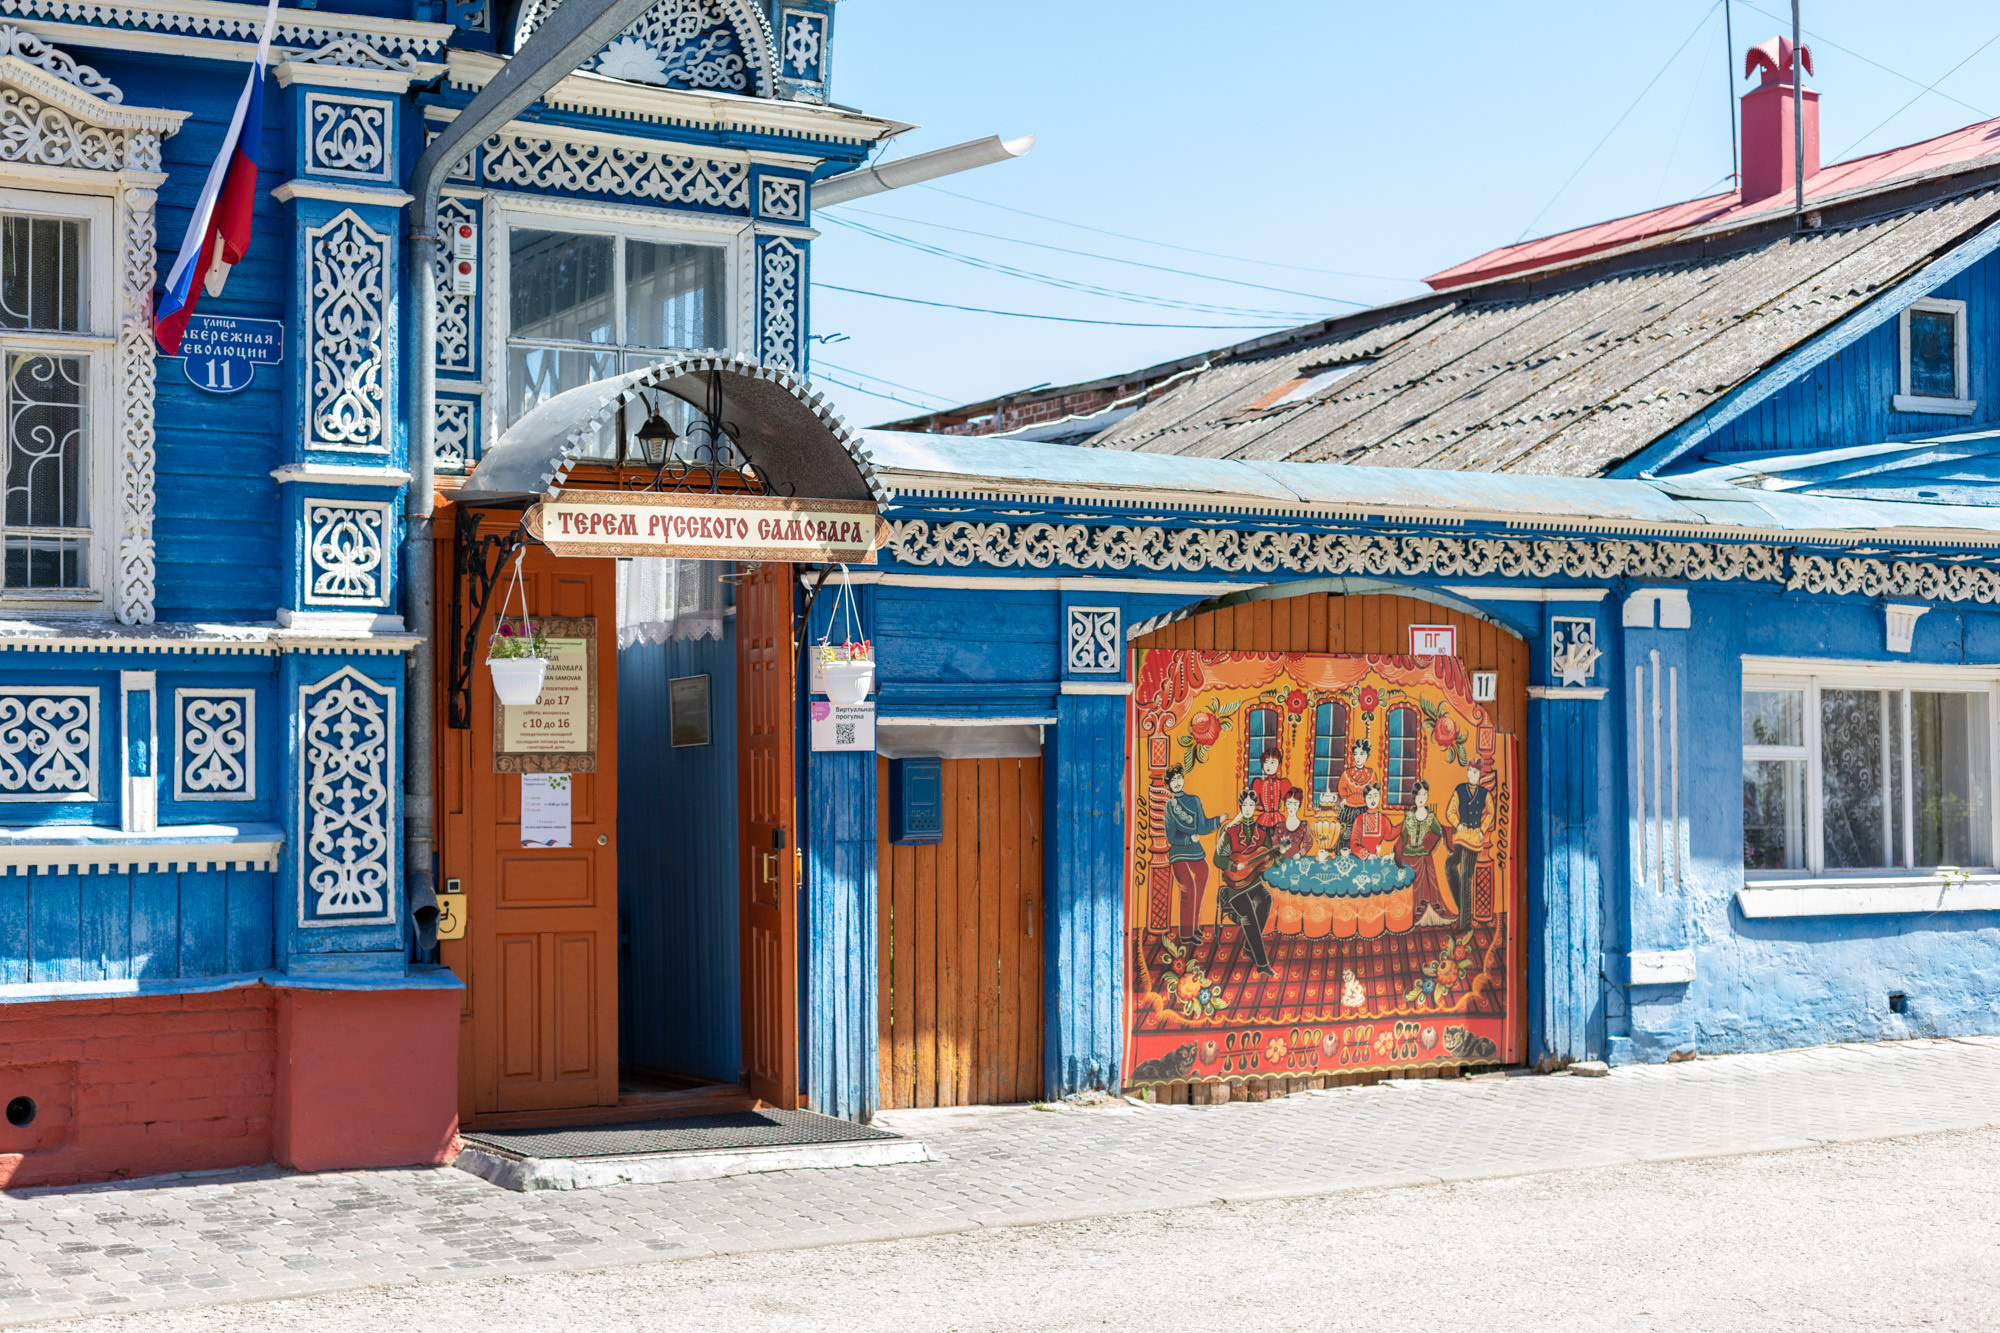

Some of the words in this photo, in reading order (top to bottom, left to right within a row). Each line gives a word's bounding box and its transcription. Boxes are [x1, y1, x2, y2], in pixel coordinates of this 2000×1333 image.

[182, 329, 273, 345] АБЕРЕЖНАЯ
[179, 342, 267, 360] ЕВОЛЮЦИИ
[205, 358, 233, 389] 11
[558, 511, 638, 535] ТЕРЕМ
[647, 514, 749, 543] РУССКОГО
[757, 518, 864, 543] САМОВАРА
[1425, 633, 1440, 648] ПГ
[1477, 676, 1490, 697] 11
[535, 695, 542, 705] 0
[544, 698, 555, 707] до
[557, 695, 570, 705] 17
[529, 718, 542, 728] 10
[544, 721, 555, 729] до
[557, 718, 570, 728] 16
